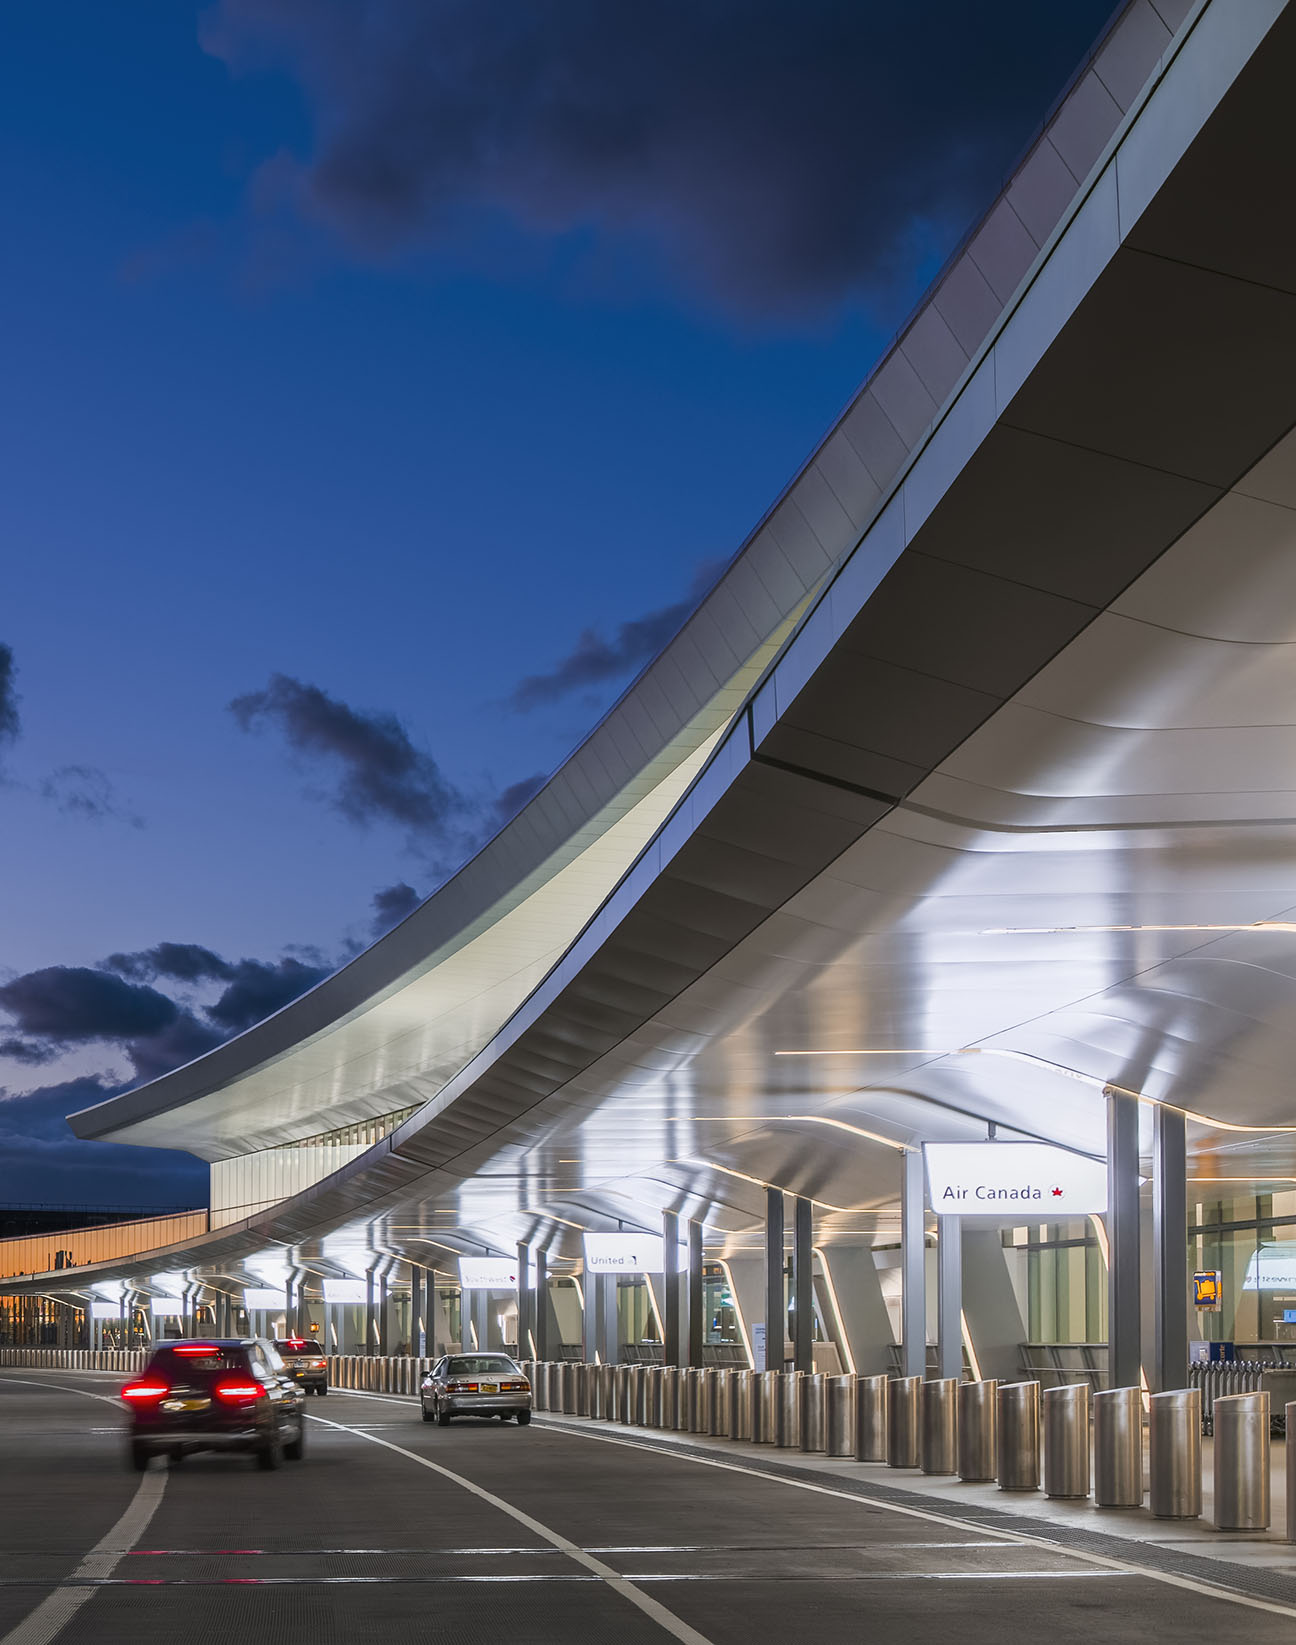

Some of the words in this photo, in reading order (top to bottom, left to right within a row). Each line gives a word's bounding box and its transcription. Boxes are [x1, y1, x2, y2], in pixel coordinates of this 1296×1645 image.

[943, 1186, 969, 1200] Air
[975, 1185, 1042, 1200] Canada
[591, 1256, 624, 1265] United
